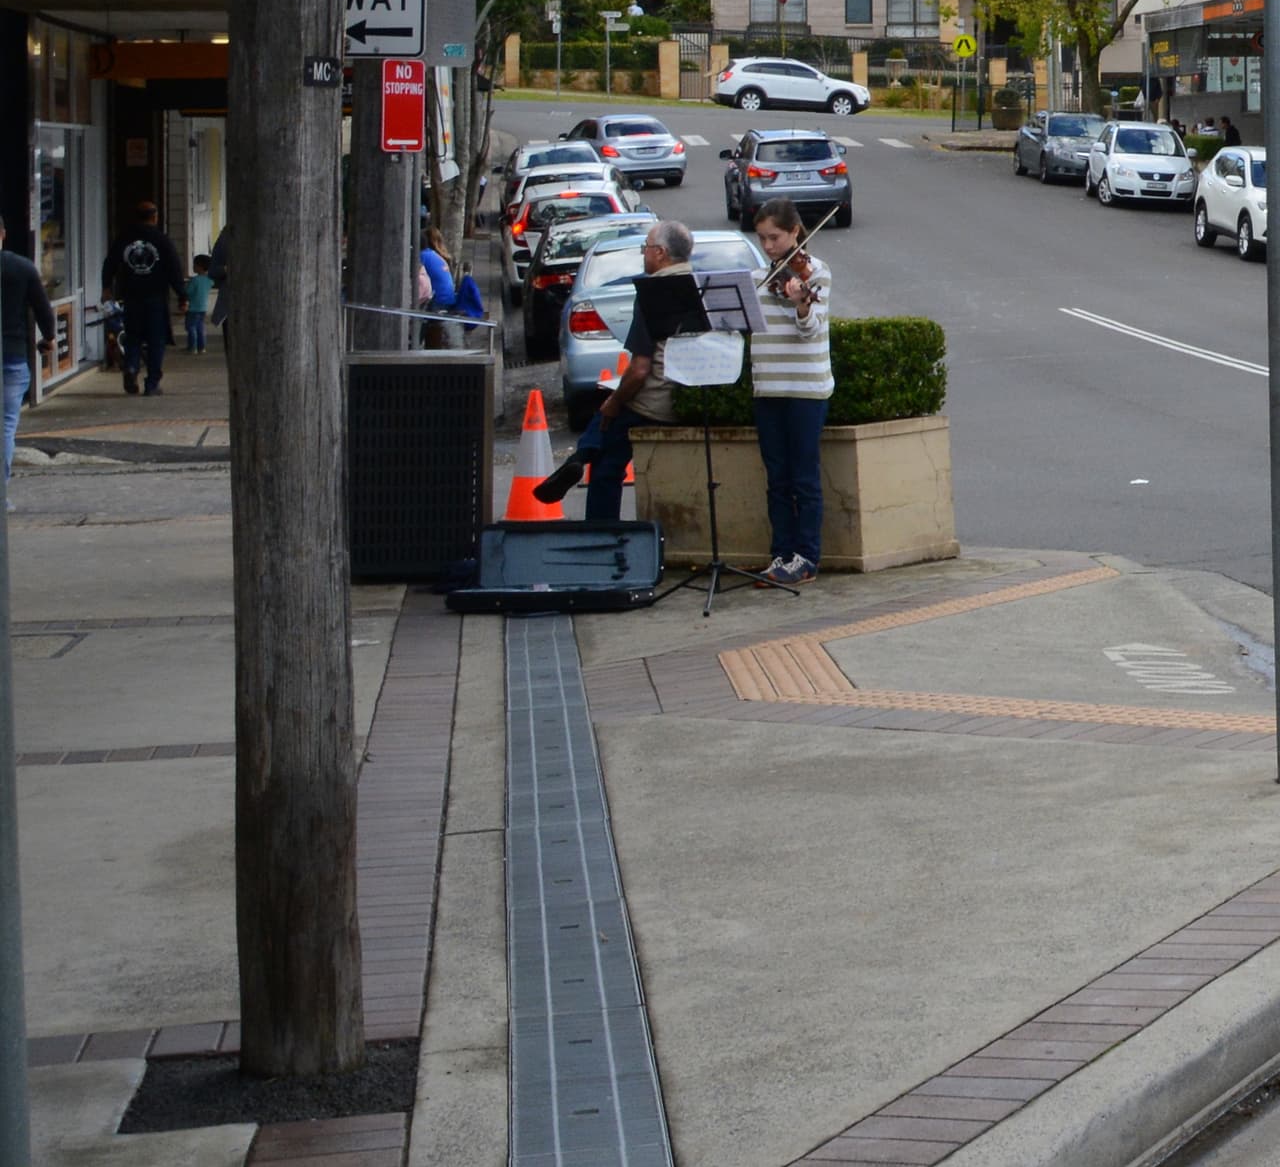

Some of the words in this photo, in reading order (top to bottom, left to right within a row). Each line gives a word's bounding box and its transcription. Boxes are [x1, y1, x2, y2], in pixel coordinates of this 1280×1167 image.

[313, 62, 331, 81] MC
[395, 64, 413, 80] NO
[384, 82, 424, 95] STOPPING
